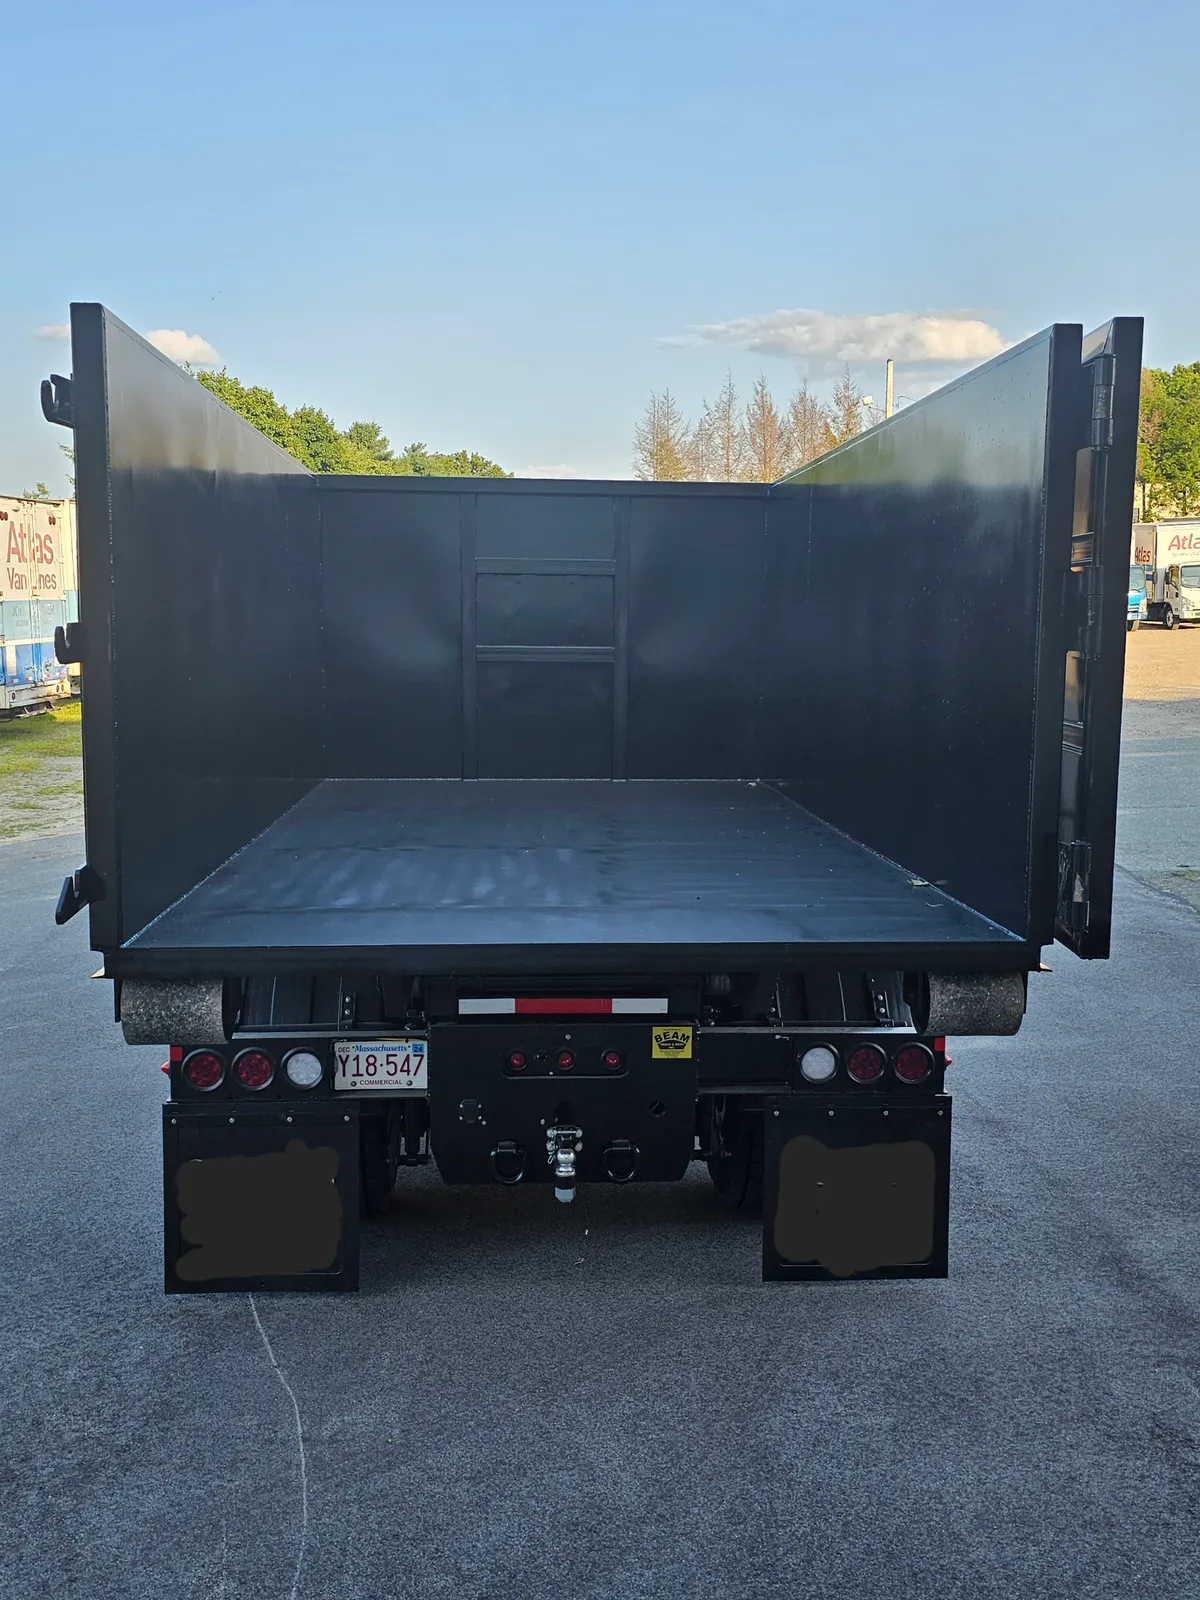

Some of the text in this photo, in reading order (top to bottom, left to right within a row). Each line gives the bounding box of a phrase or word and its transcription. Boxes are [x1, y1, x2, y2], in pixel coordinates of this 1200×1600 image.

[7, 521, 54, 564] Atlas
[1135, 547, 1151, 562] Atlas
[7, 567, 27, 589] Van
[654, 1031, 691, 1043] BEAM
[354, 1044, 408, 1053] Massachusetts
